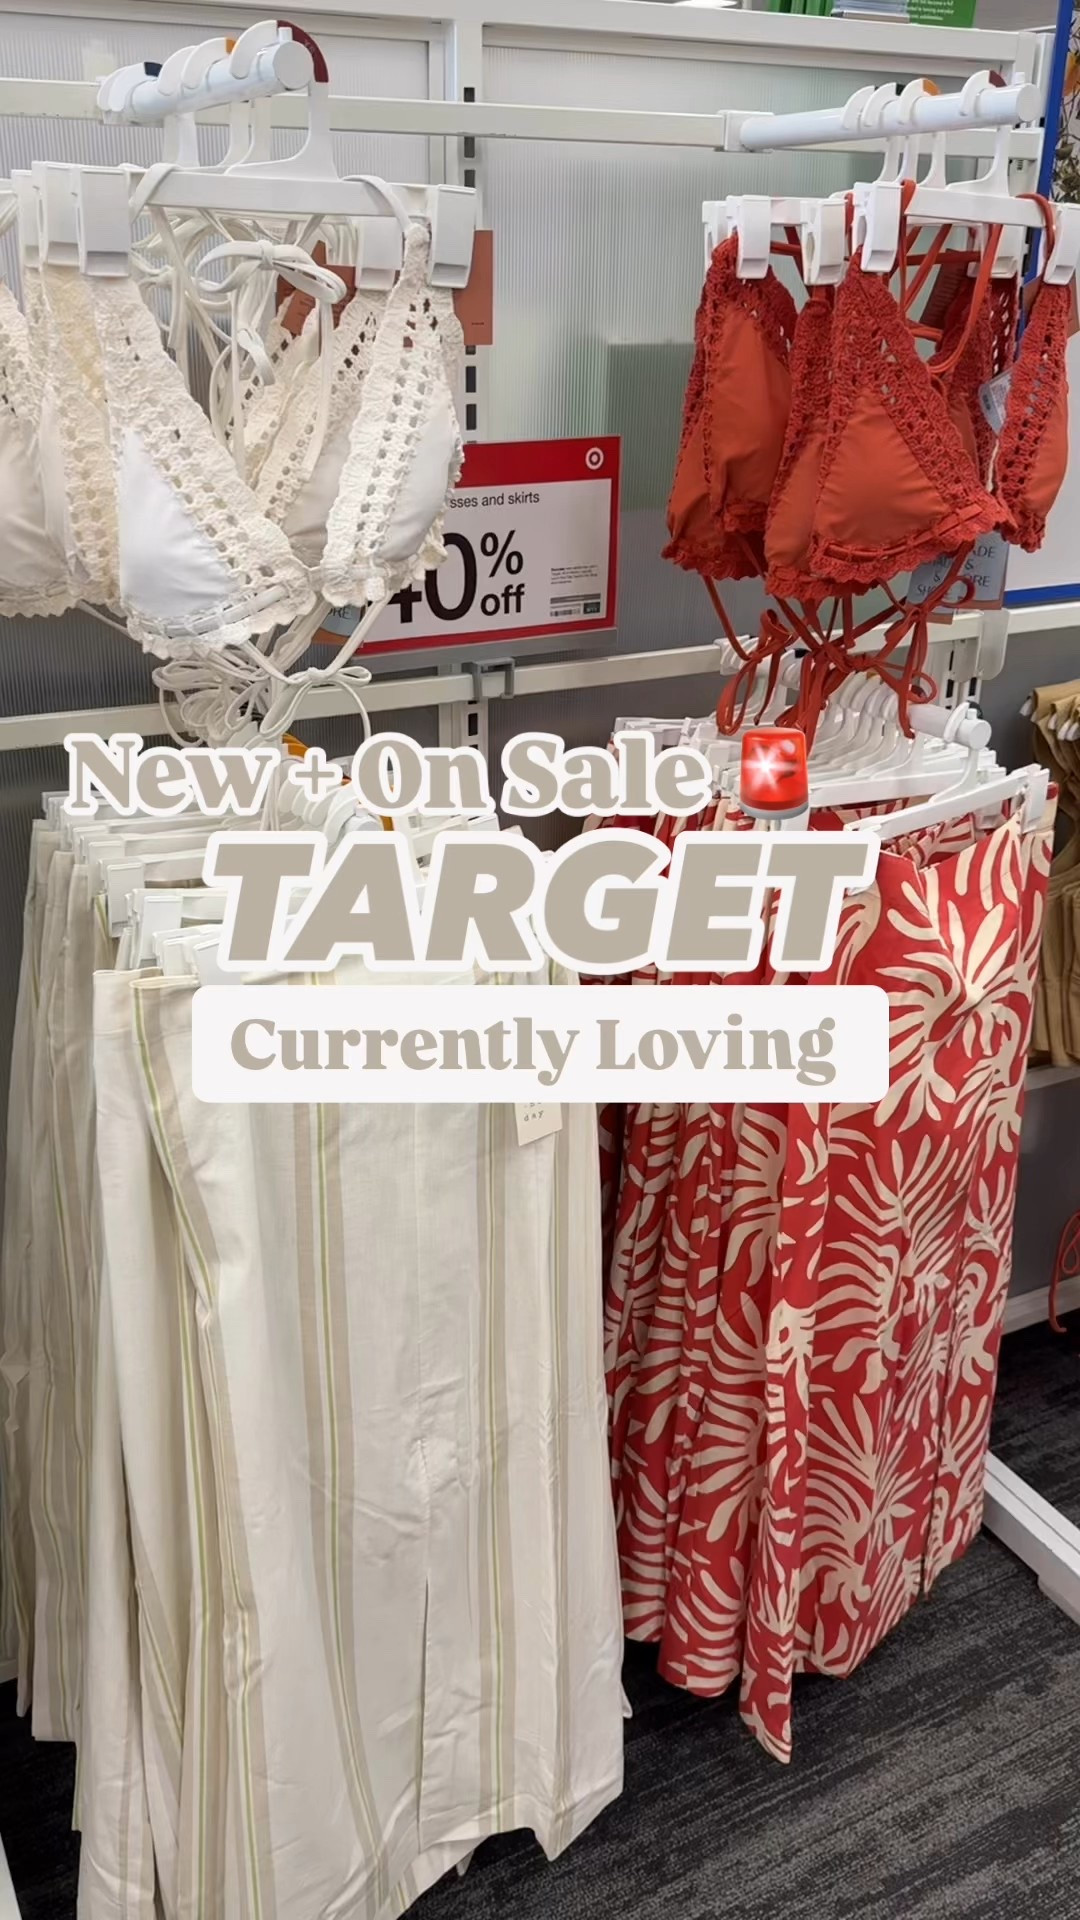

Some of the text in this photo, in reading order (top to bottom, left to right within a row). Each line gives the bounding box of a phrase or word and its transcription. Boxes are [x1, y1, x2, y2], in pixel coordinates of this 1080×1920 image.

[449, 491, 540, 509] sses and skirts
[480, 583, 526, 617] off
